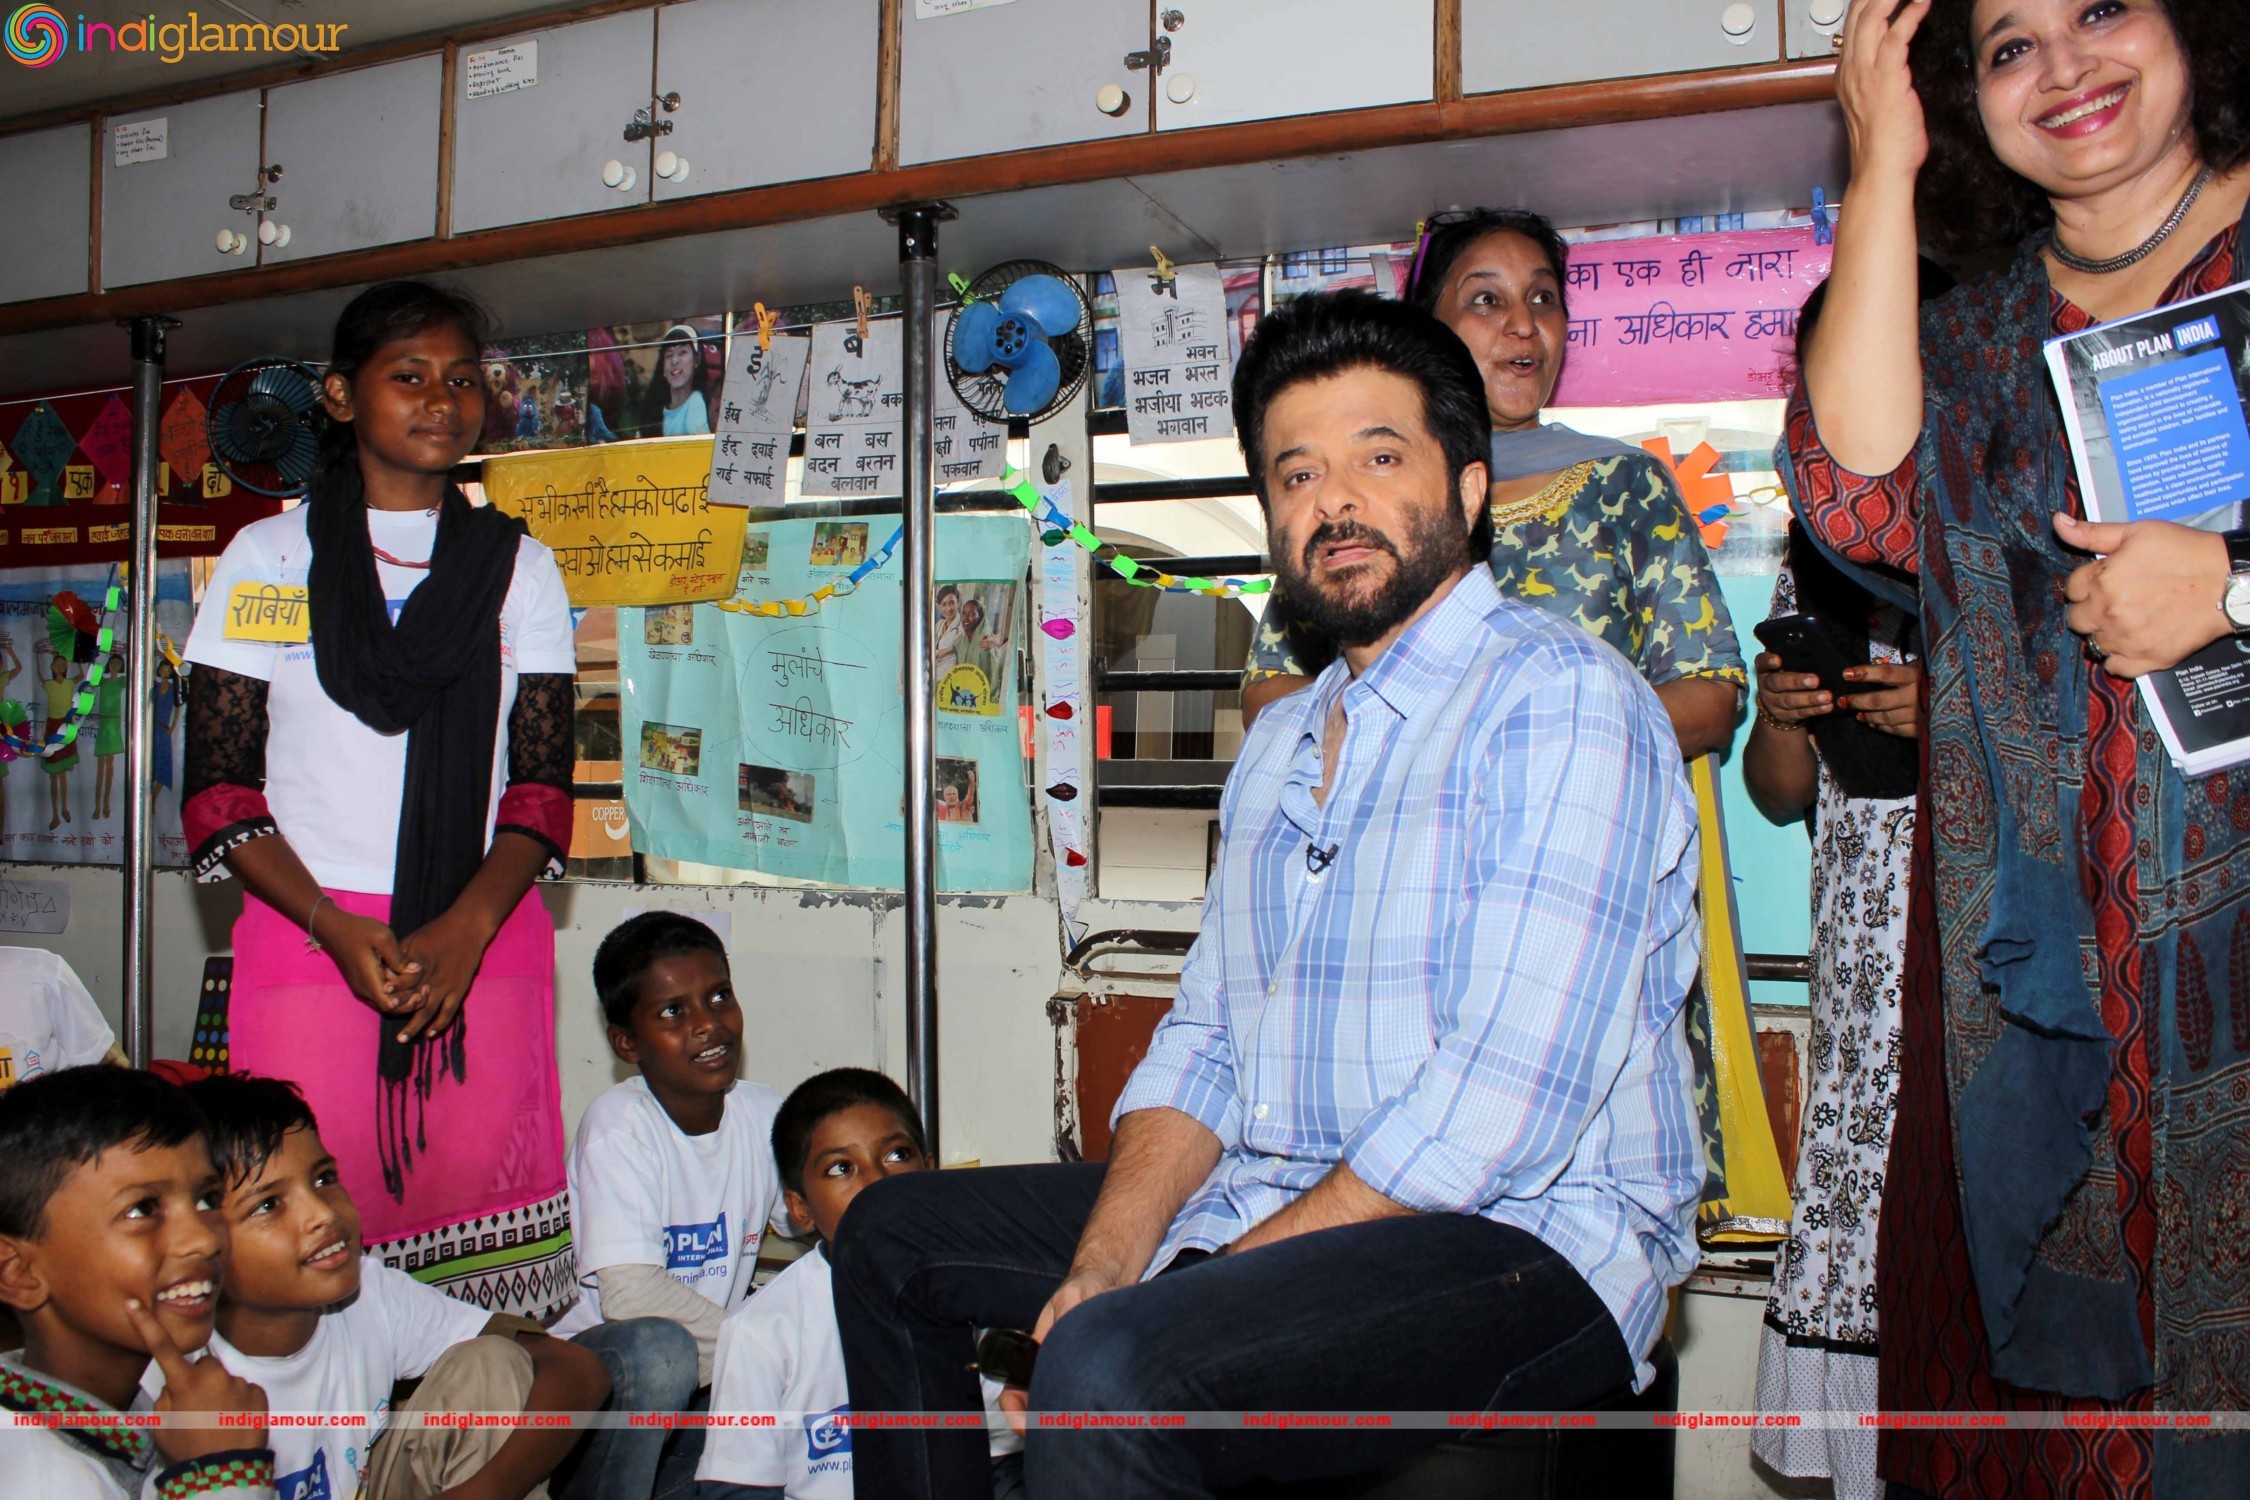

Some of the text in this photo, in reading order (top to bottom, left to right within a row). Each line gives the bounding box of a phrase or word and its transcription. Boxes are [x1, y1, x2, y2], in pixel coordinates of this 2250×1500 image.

[1613, 260, 1661, 288] एक
[1679, 250, 1712, 287] ही
[1726, 250, 1799, 282] नारा
[1615, 301, 1735, 345] अधिकार
[1186, 345, 1218, 359] भवन
[2092, 321, 2214, 372] ABOUT PLAN INDIA
[1134, 364, 1220, 386] भजन भरत
[725, 402, 742, 424] ईख
[1135, 390, 1228, 414] भजीया भटक
[934, 415, 957, 430] तला
[1158, 416, 1208, 435] भगवान
[722, 435, 777, 459] ईद दवाई
[815, 431, 892, 448] बल बस
[969, 432, 1000, 452] पपीता
[808, 454, 896, 474] बदन बरतन
[941, 461, 982, 477] पकवान
[69, 471, 93, 497] एक
[716, 463, 775, 489] राई सफाई
[831, 475, 879, 491] बलवान
[654, 528, 712, 571] कमाई
[687, 649, 717, 667] अधिकार
[768, 696, 854, 748] अधिकार
[675, 779, 710, 796] अधिकार
[592, 806, 624, 821] COPPER
[677, 1224, 723, 1251] PLAN
